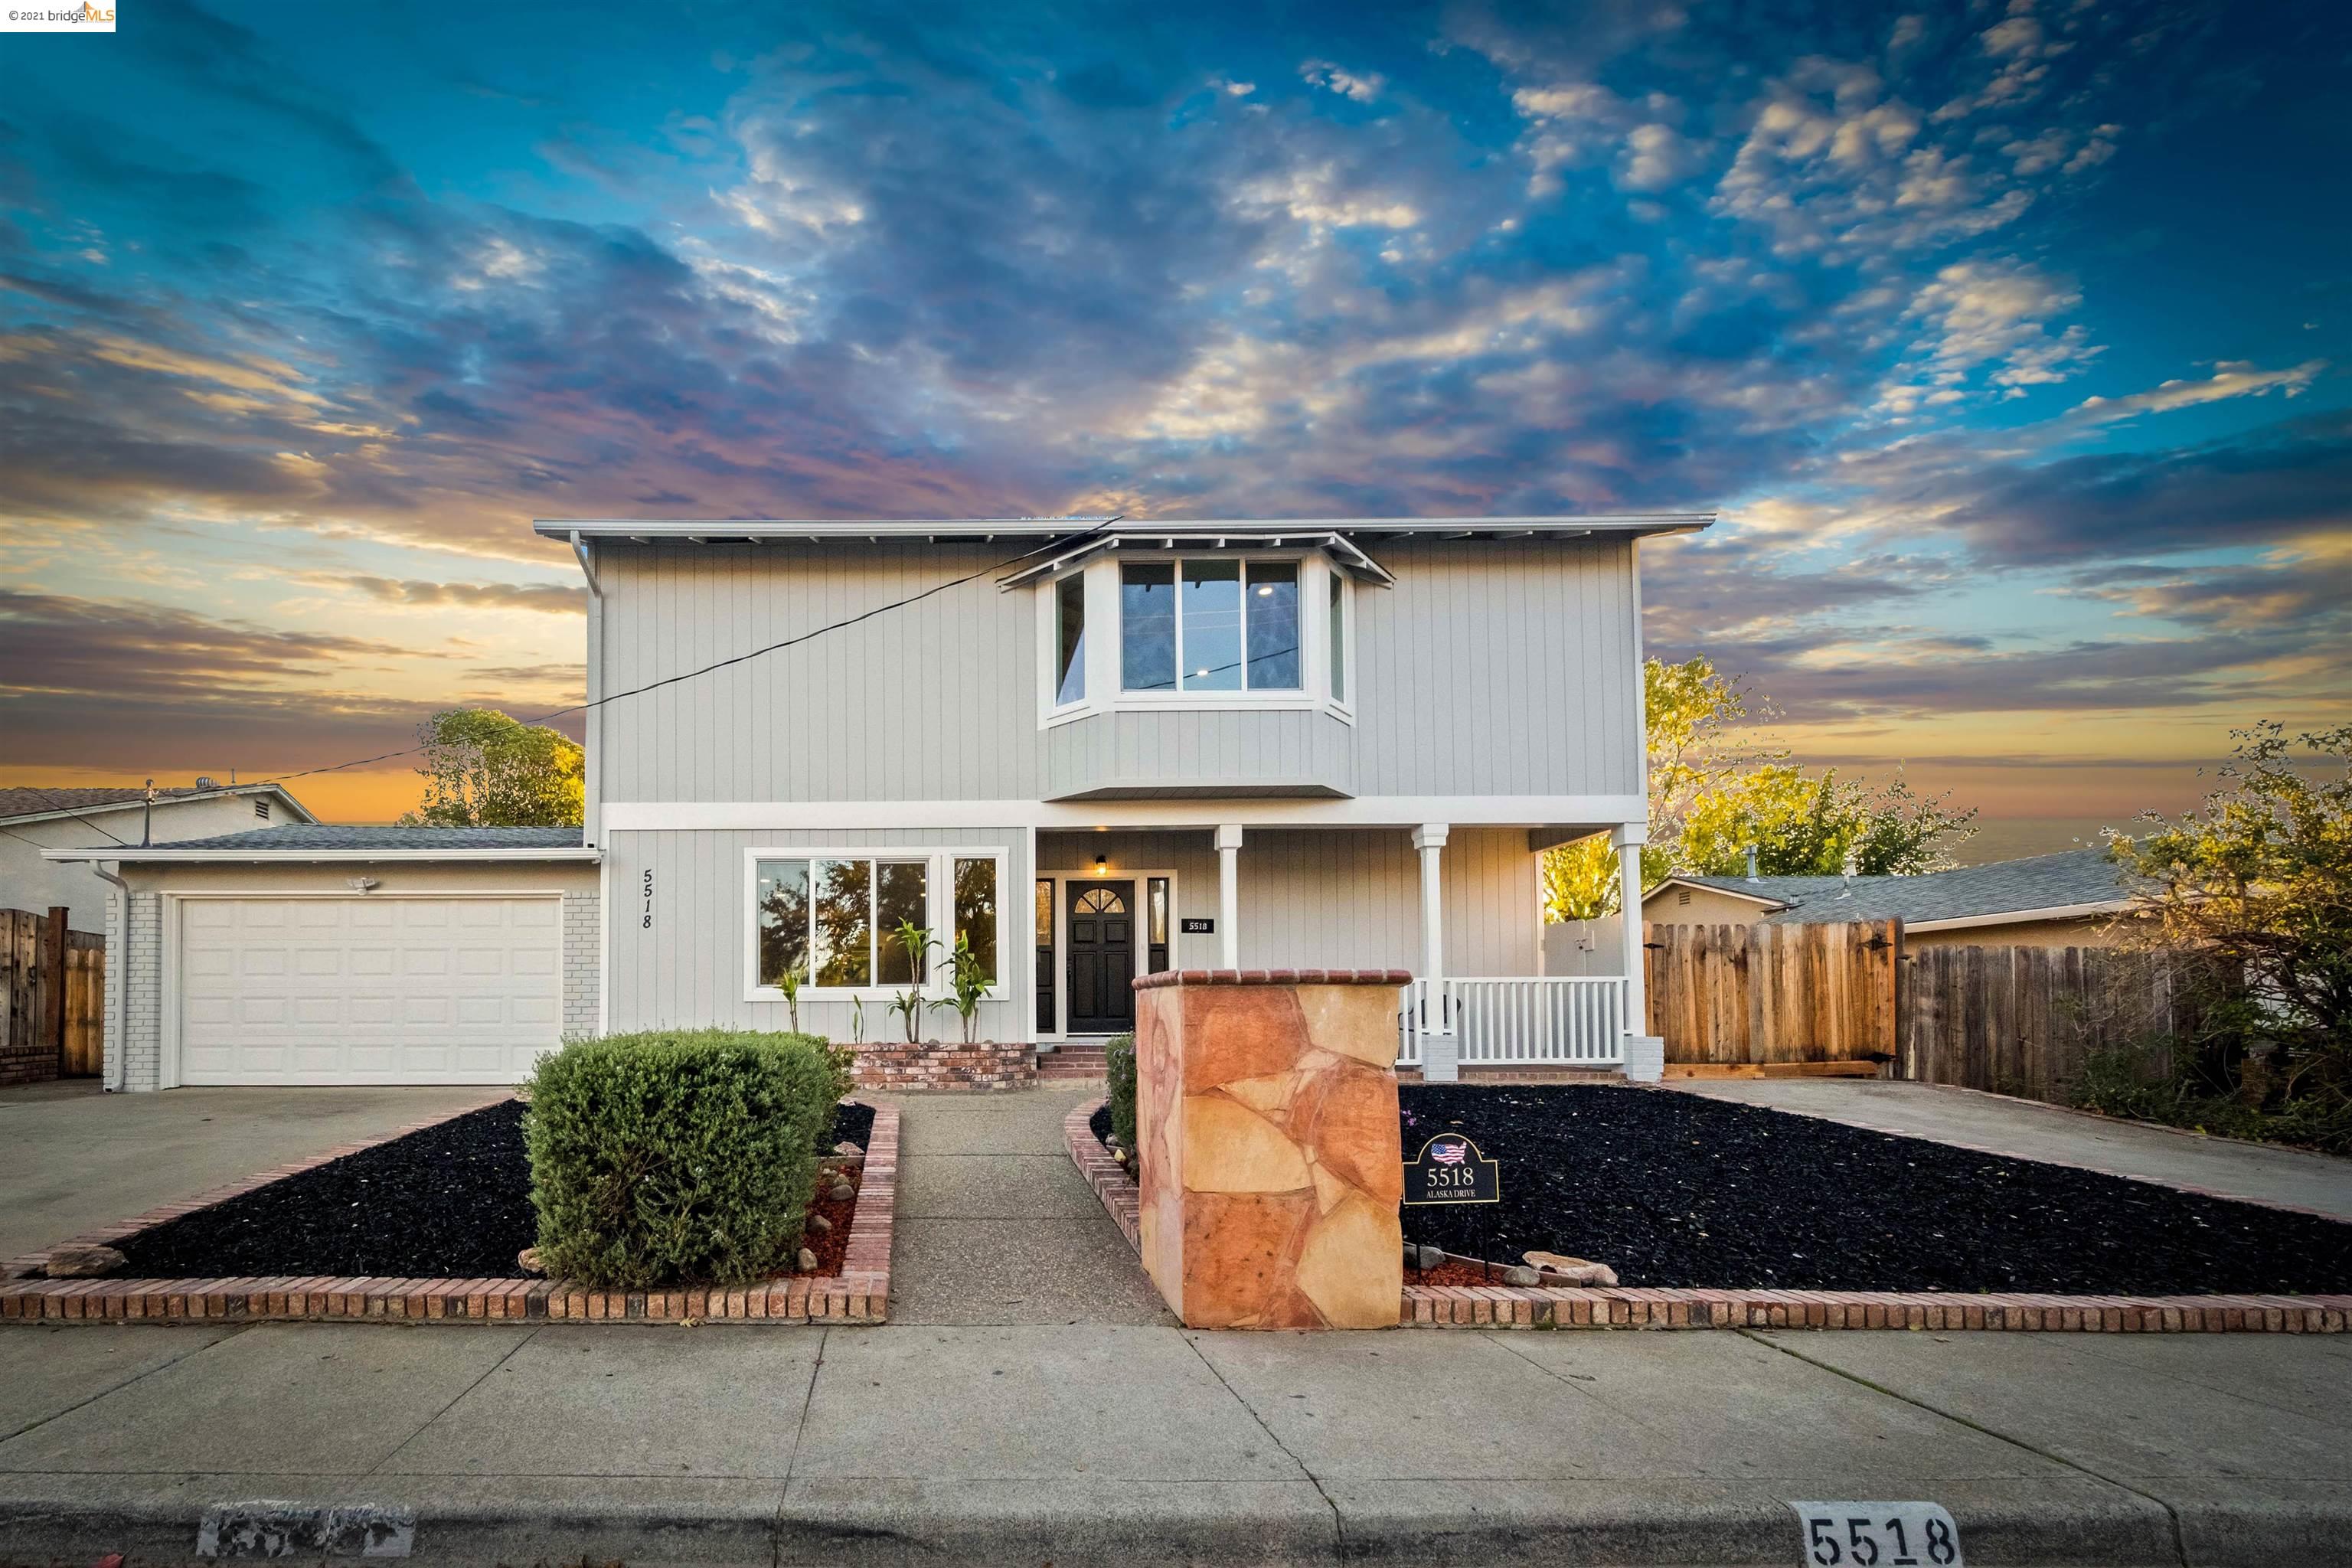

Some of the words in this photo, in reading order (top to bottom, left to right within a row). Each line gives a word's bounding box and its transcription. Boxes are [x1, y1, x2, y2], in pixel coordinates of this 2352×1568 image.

[643, 868, 652, 929] 5518
[1189, 922, 1207, 930] 5518
[1426, 1167, 1474, 1187] 5518
[1426, 1190, 1452, 1198] ALASKA
[1454, 1189, 1476, 1198] DRIVE
[1809, 1517, 1955, 1566] 5518
